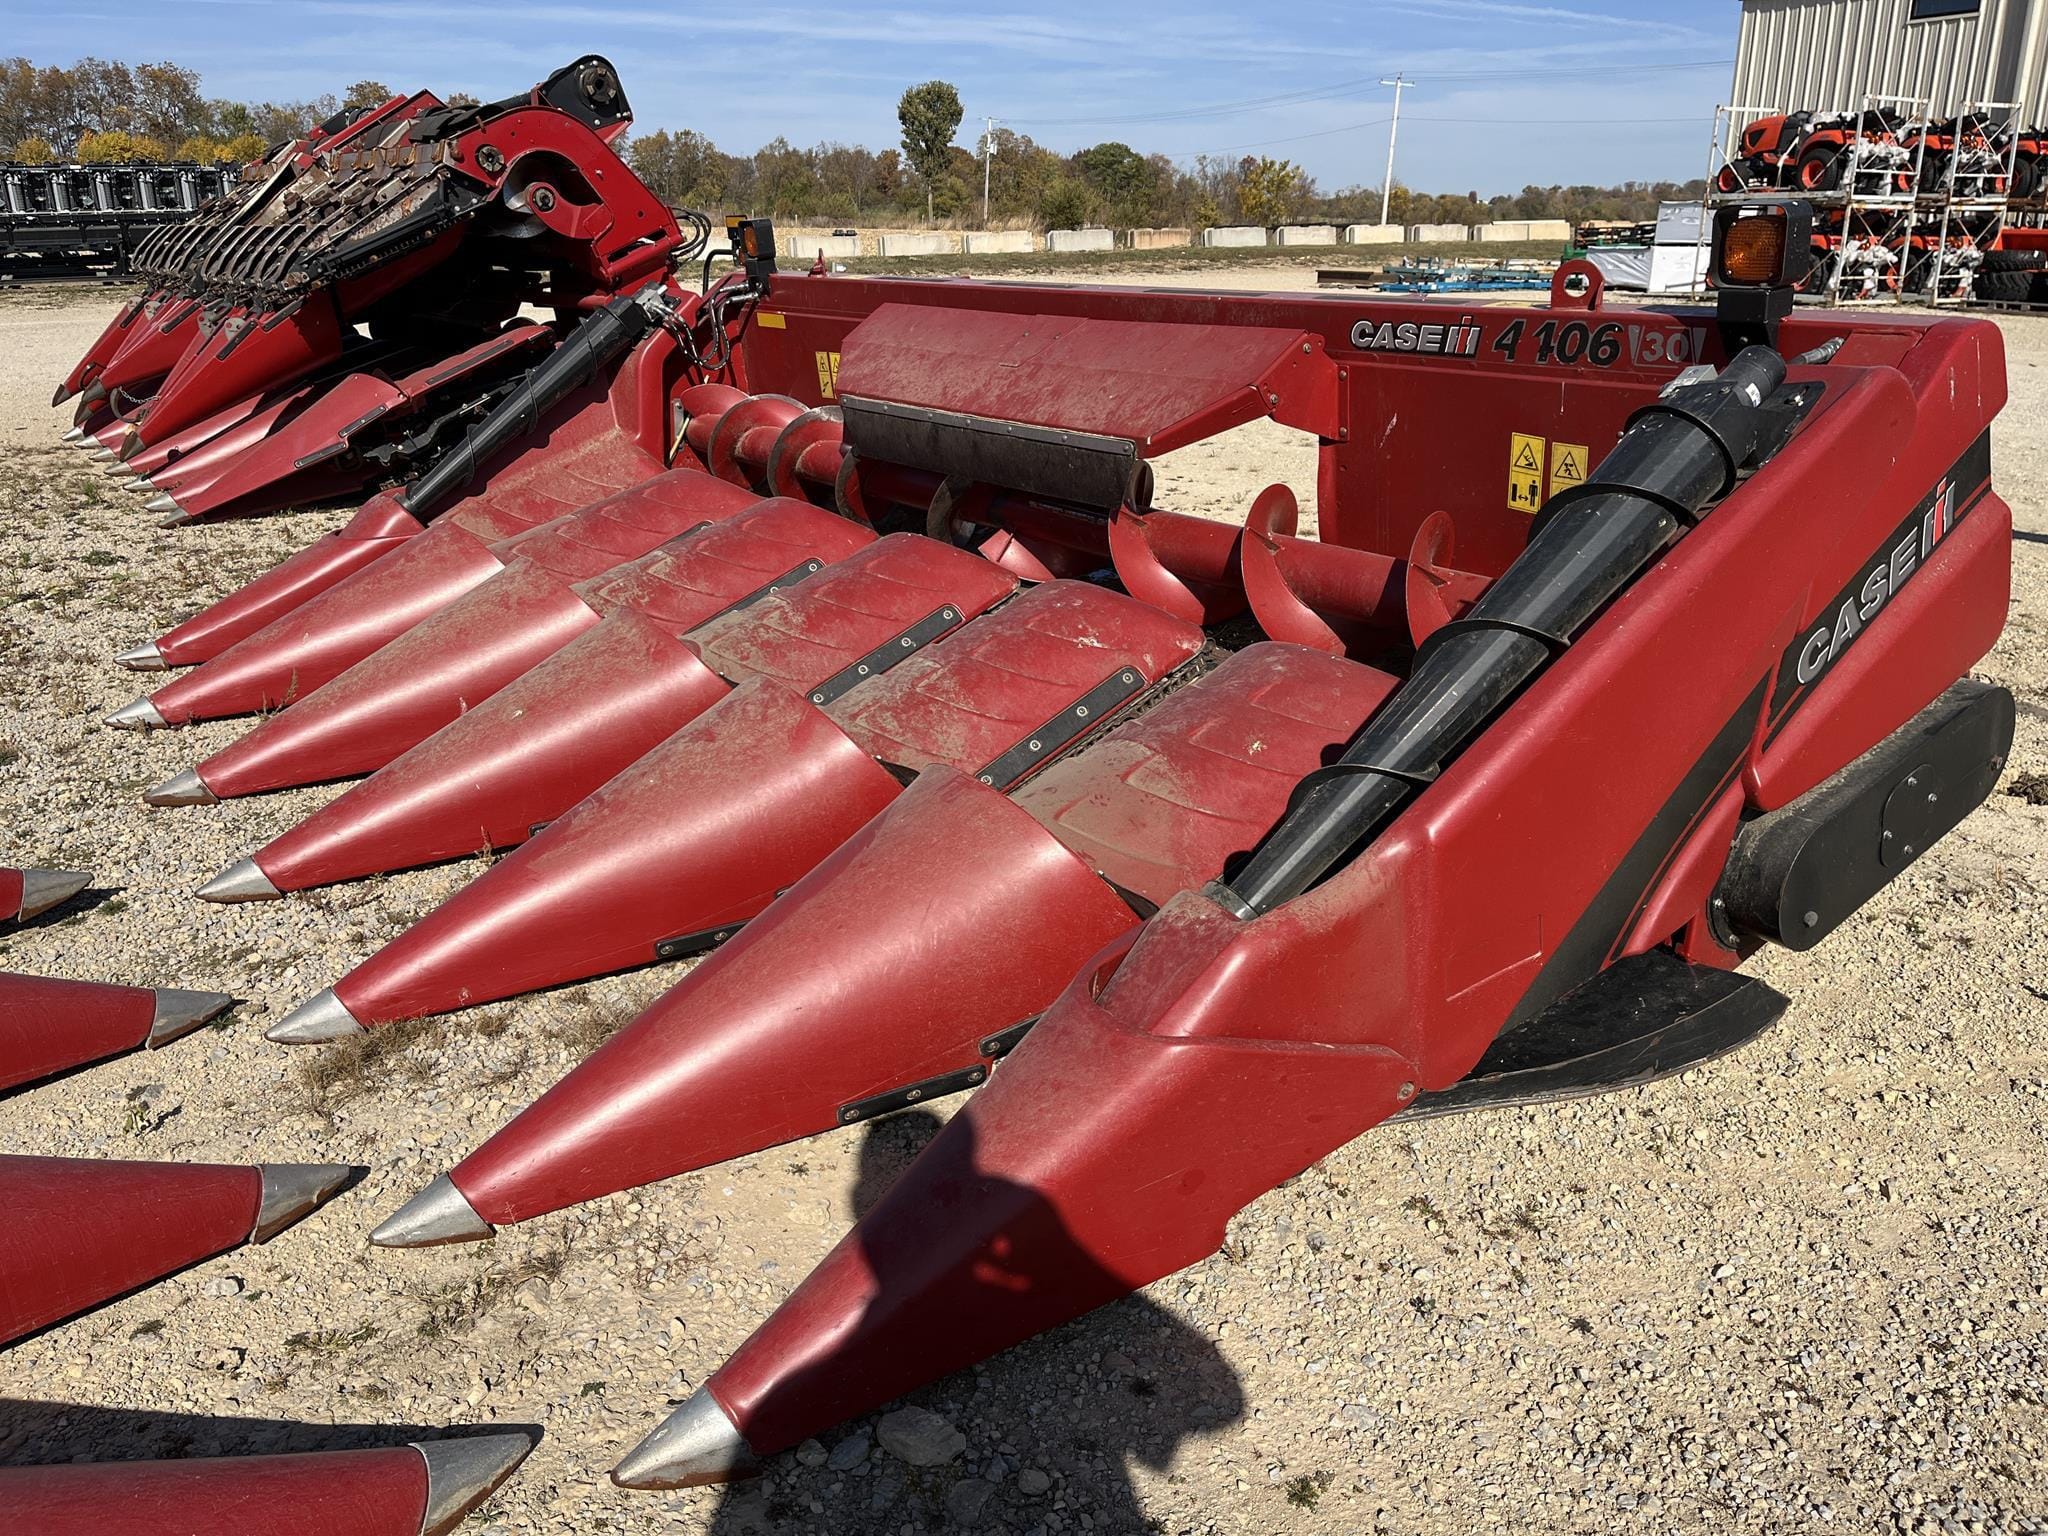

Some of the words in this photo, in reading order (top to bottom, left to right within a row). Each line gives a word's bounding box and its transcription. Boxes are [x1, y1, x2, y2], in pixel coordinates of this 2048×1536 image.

[1351, 320, 1444, 352] CASE
[1642, 331, 1691, 363] 30
[1797, 526, 1918, 684] CASE
